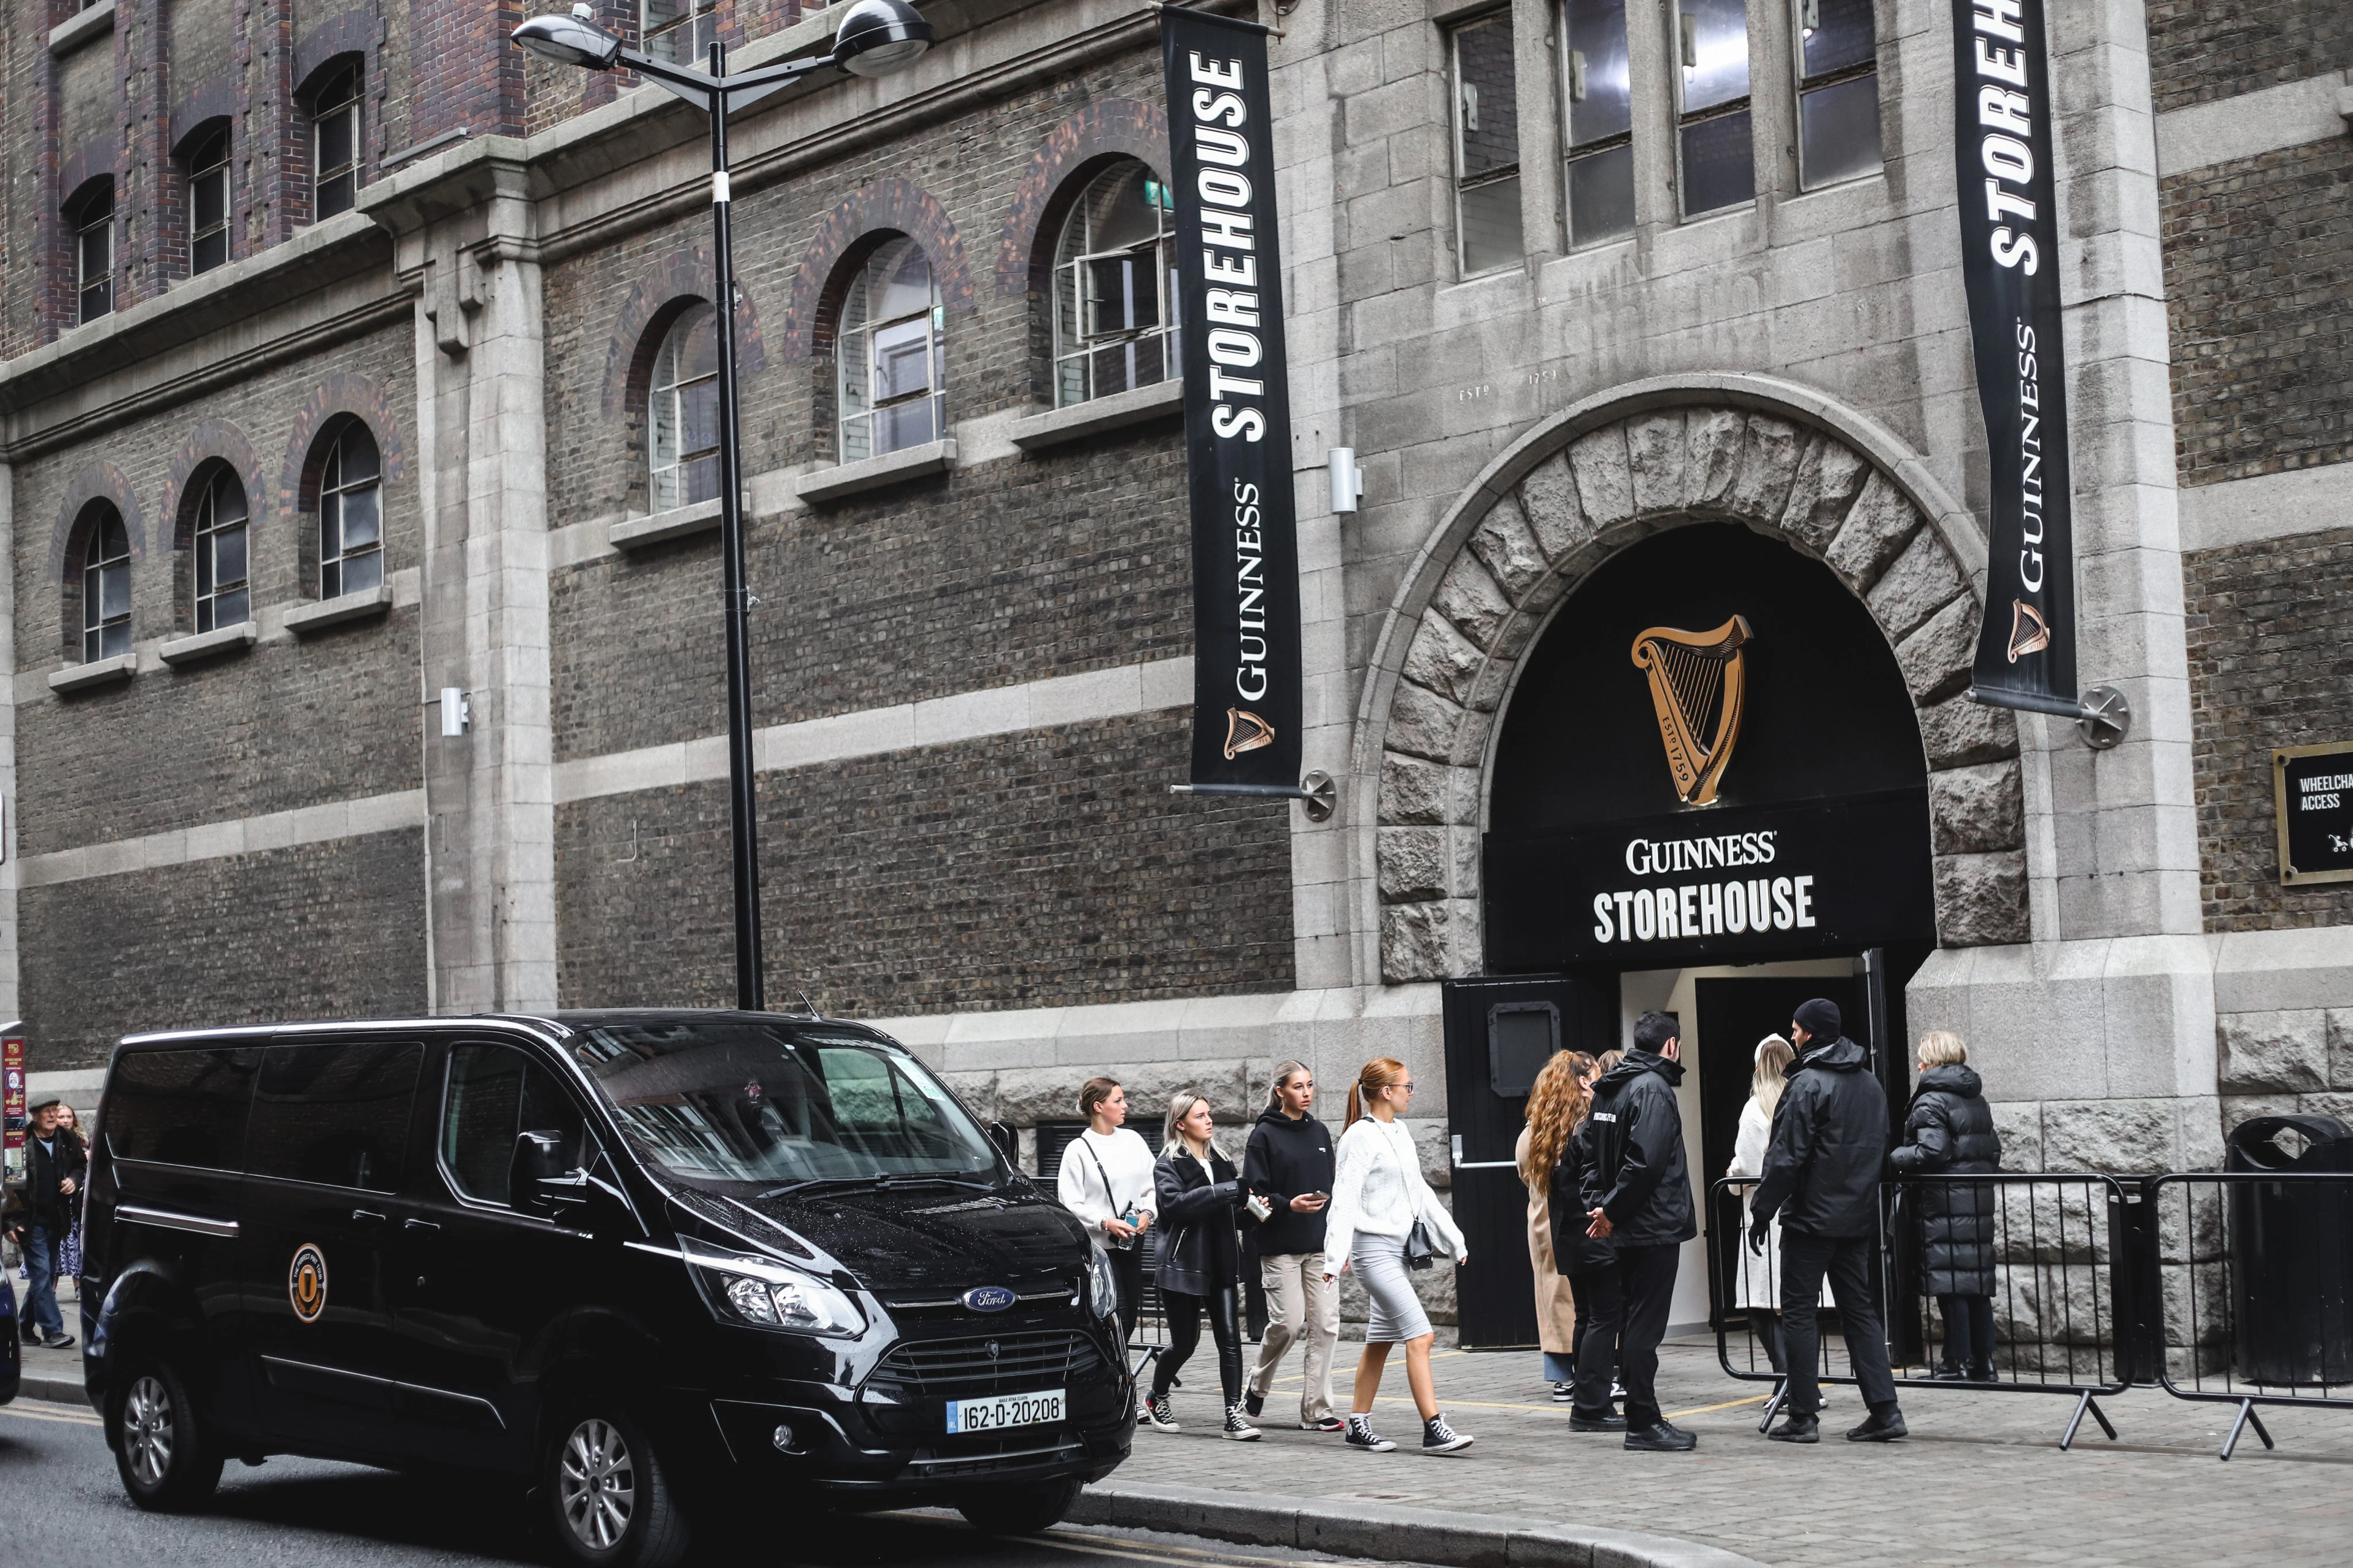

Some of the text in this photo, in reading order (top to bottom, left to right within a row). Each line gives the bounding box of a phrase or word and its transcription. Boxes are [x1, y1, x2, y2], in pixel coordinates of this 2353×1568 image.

[1189, 50, 1267, 443] STOREHOUSE
[2017, 324, 2043, 593] GUINNESS
[1236, 482, 1267, 701] GUINNESS
[1662, 717, 1689, 782] ESTD 1759
[2301, 793, 2340, 810] ACCESS
[1626, 831, 1776, 875] GUINNESS
[1594, 875, 1816, 943] STOREHOUSE
[978, 1291, 1006, 1307] Ford
[964, 1397, 1059, 1430] 162-D-20208
